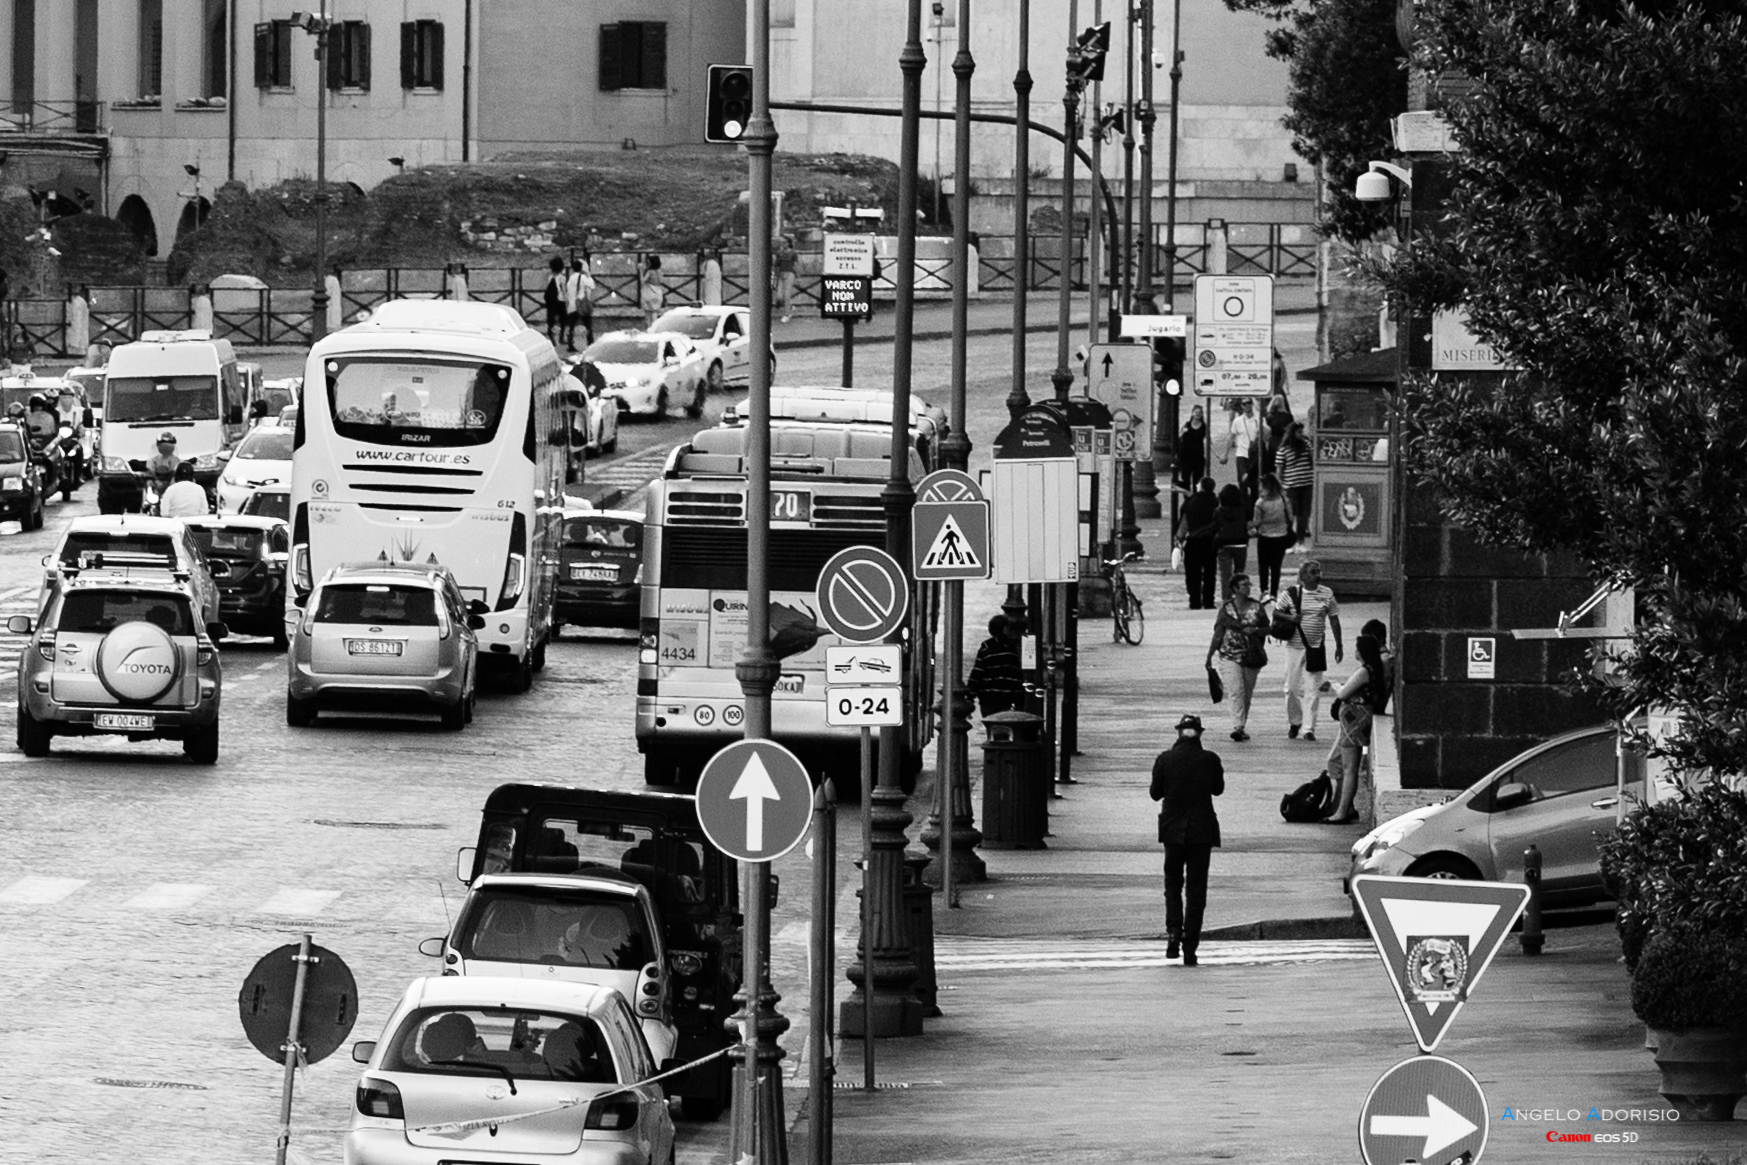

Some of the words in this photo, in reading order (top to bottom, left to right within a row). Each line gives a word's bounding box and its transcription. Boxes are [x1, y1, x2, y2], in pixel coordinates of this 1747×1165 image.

[825, 280, 862, 290] VARCO
[832, 291, 855, 301] NON
[825, 302, 869, 313] ATTIVO
[1442, 349, 1498, 361] MISERI
[401, 433, 431, 442] IRIZAR
[356, 450, 471, 465] www.cartour.es
[497, 500, 516, 509] 612
[713, 598, 748, 613] QUIRIN
[661, 647, 696, 660] 4434
[123, 663, 172, 675] TOYOTA
[838, 697, 890, 715] 0-24
[699, 710, 709, 720] 80
[727, 710, 740, 719] 100
